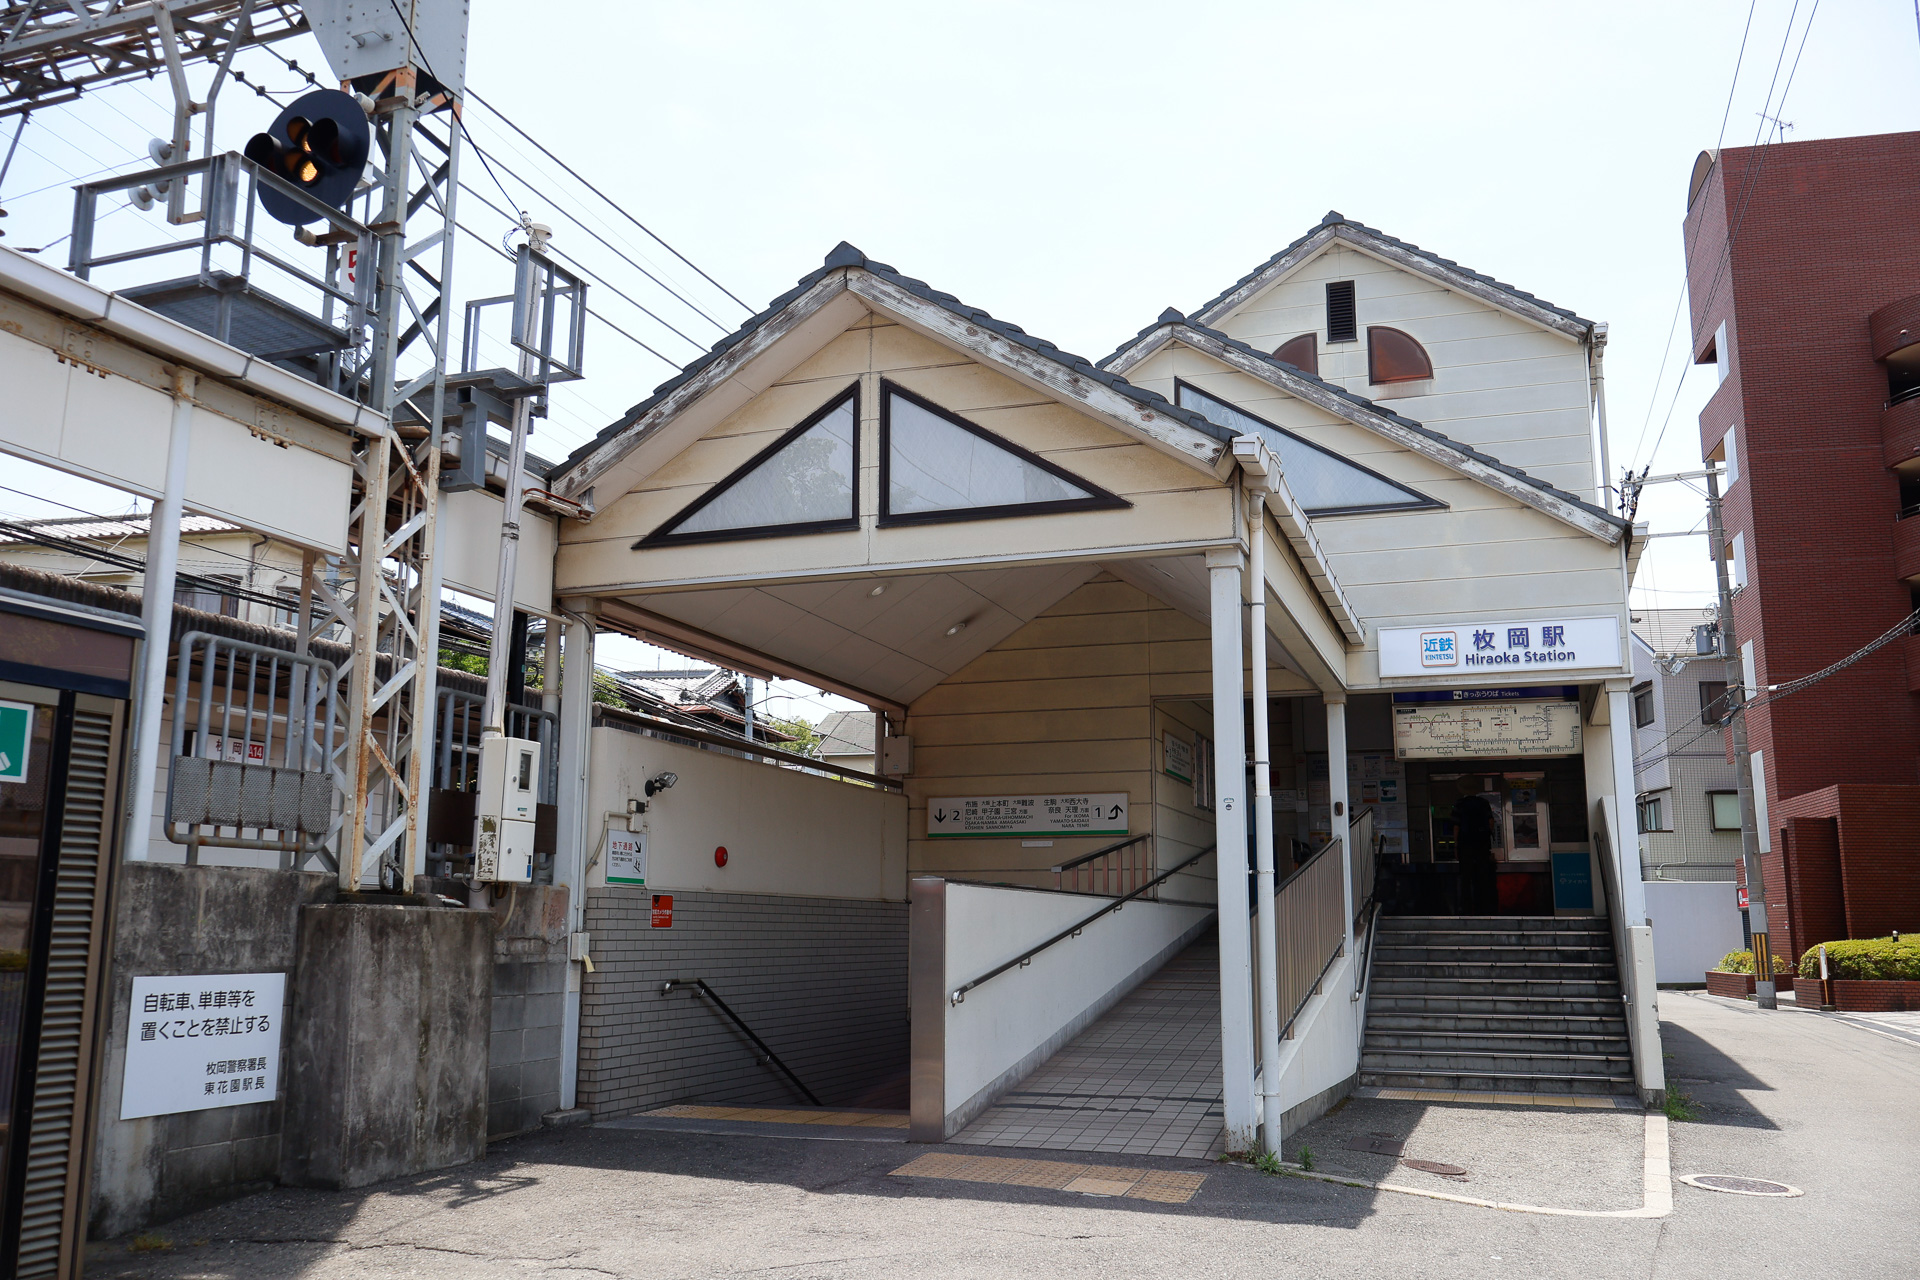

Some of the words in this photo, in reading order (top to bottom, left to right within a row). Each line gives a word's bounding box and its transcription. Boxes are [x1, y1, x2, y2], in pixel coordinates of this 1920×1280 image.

[1473, 625, 1566, 650] 枚岡駅
[1424, 637, 1454, 652] 近鉄
[1425, 653, 1454, 661] KINTETSU
[1465, 652, 1520, 665] Hiraoka
[1524, 649, 1576, 663] Station
[1463, 690, 1499, 698] きっぷうりば
[965, 800, 978, 808] 布施
[1043, 798, 1057, 806] 生駒
[952, 810, 960, 820] 2
[981, 807, 1001, 816] 甲子園
[1004, 807, 1017, 815] 三宮
[1048, 806, 1062, 814] 奈良
[1065, 806, 1079, 814] 天理
[1094, 806, 1101, 818] 1
[612, 840, 633, 852] 地下通路
[143, 989, 256, 1013] 自転車、単車等を
[140, 1014, 271, 1042] 置くことを禁止する
[205, 1056, 267, 1076] 枚岡警察署長
[203, 1075, 266, 1096] 東花園駅長
